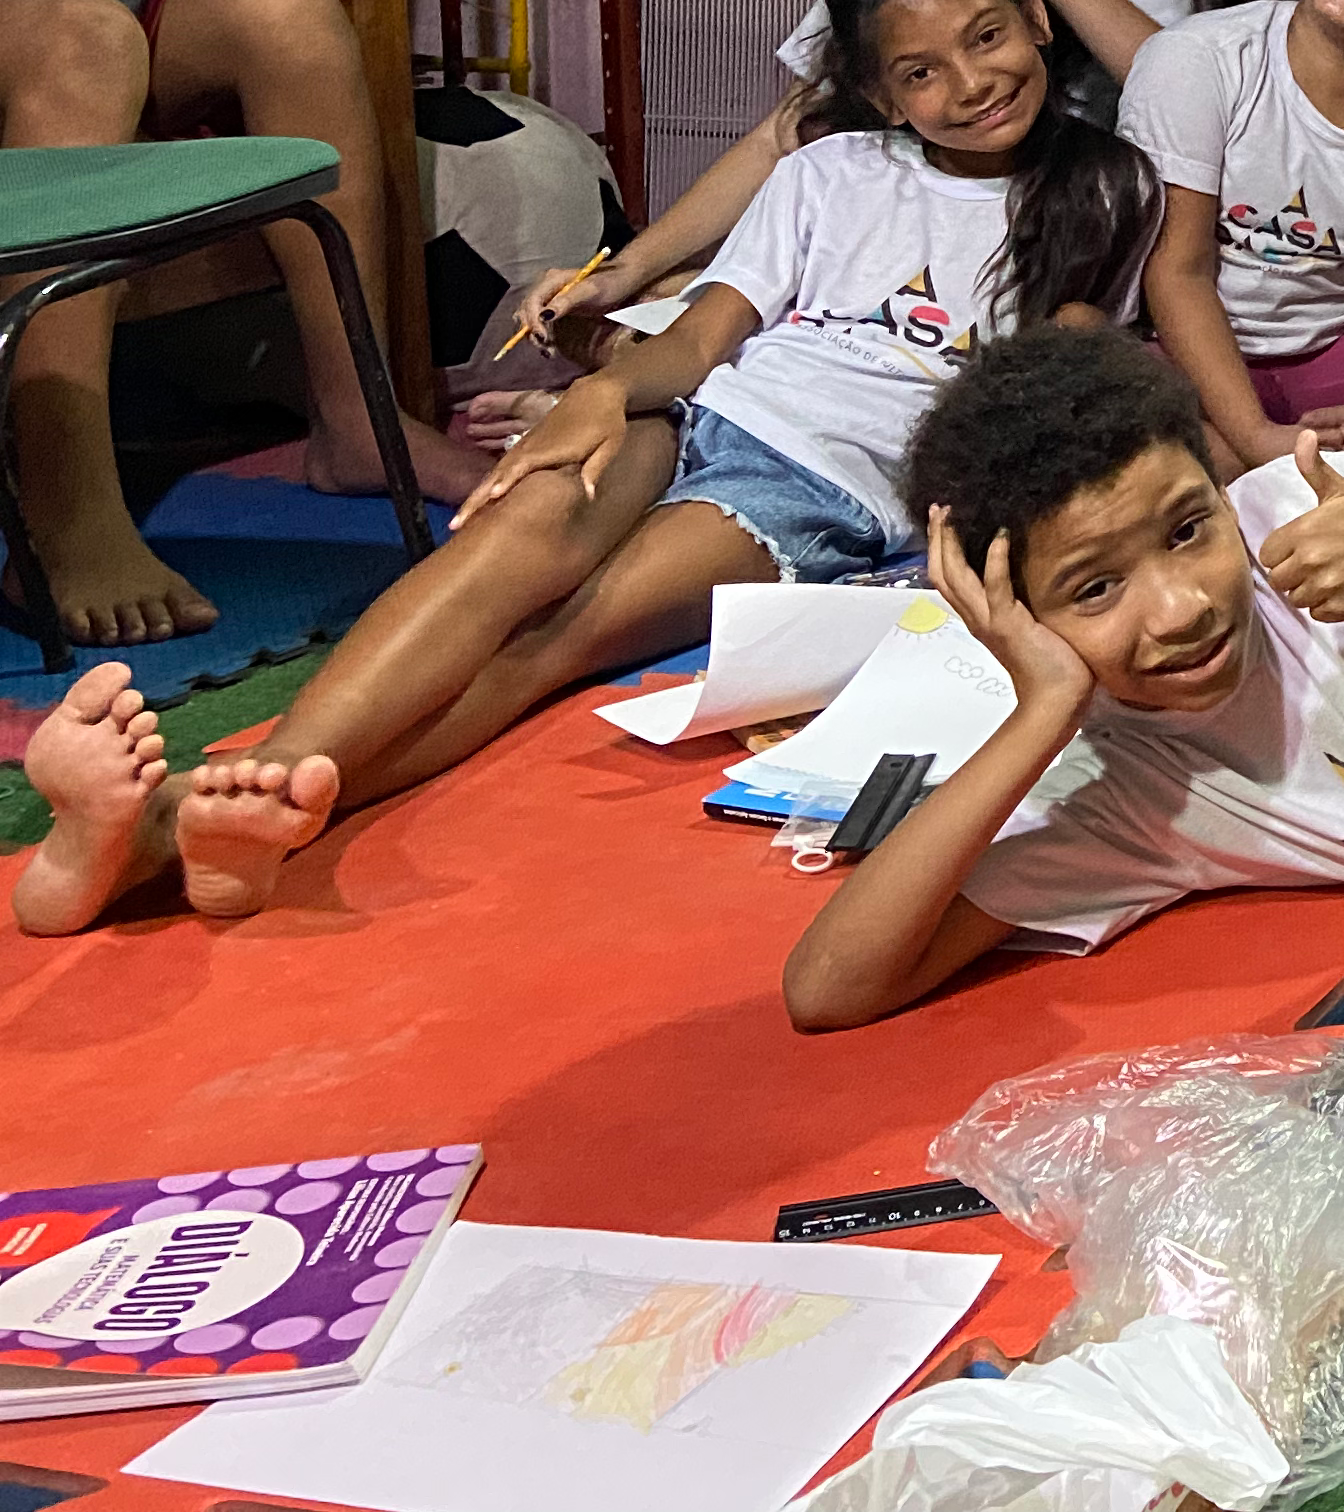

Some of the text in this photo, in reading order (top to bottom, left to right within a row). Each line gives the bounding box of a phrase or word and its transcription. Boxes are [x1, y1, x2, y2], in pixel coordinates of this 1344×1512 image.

[1281, 185, 1310, 218] A
[1228, 203, 1342, 256] CASA
[896, 264, 938, 303] A
[94, 1219, 254, 1332] DIÁLOGO
